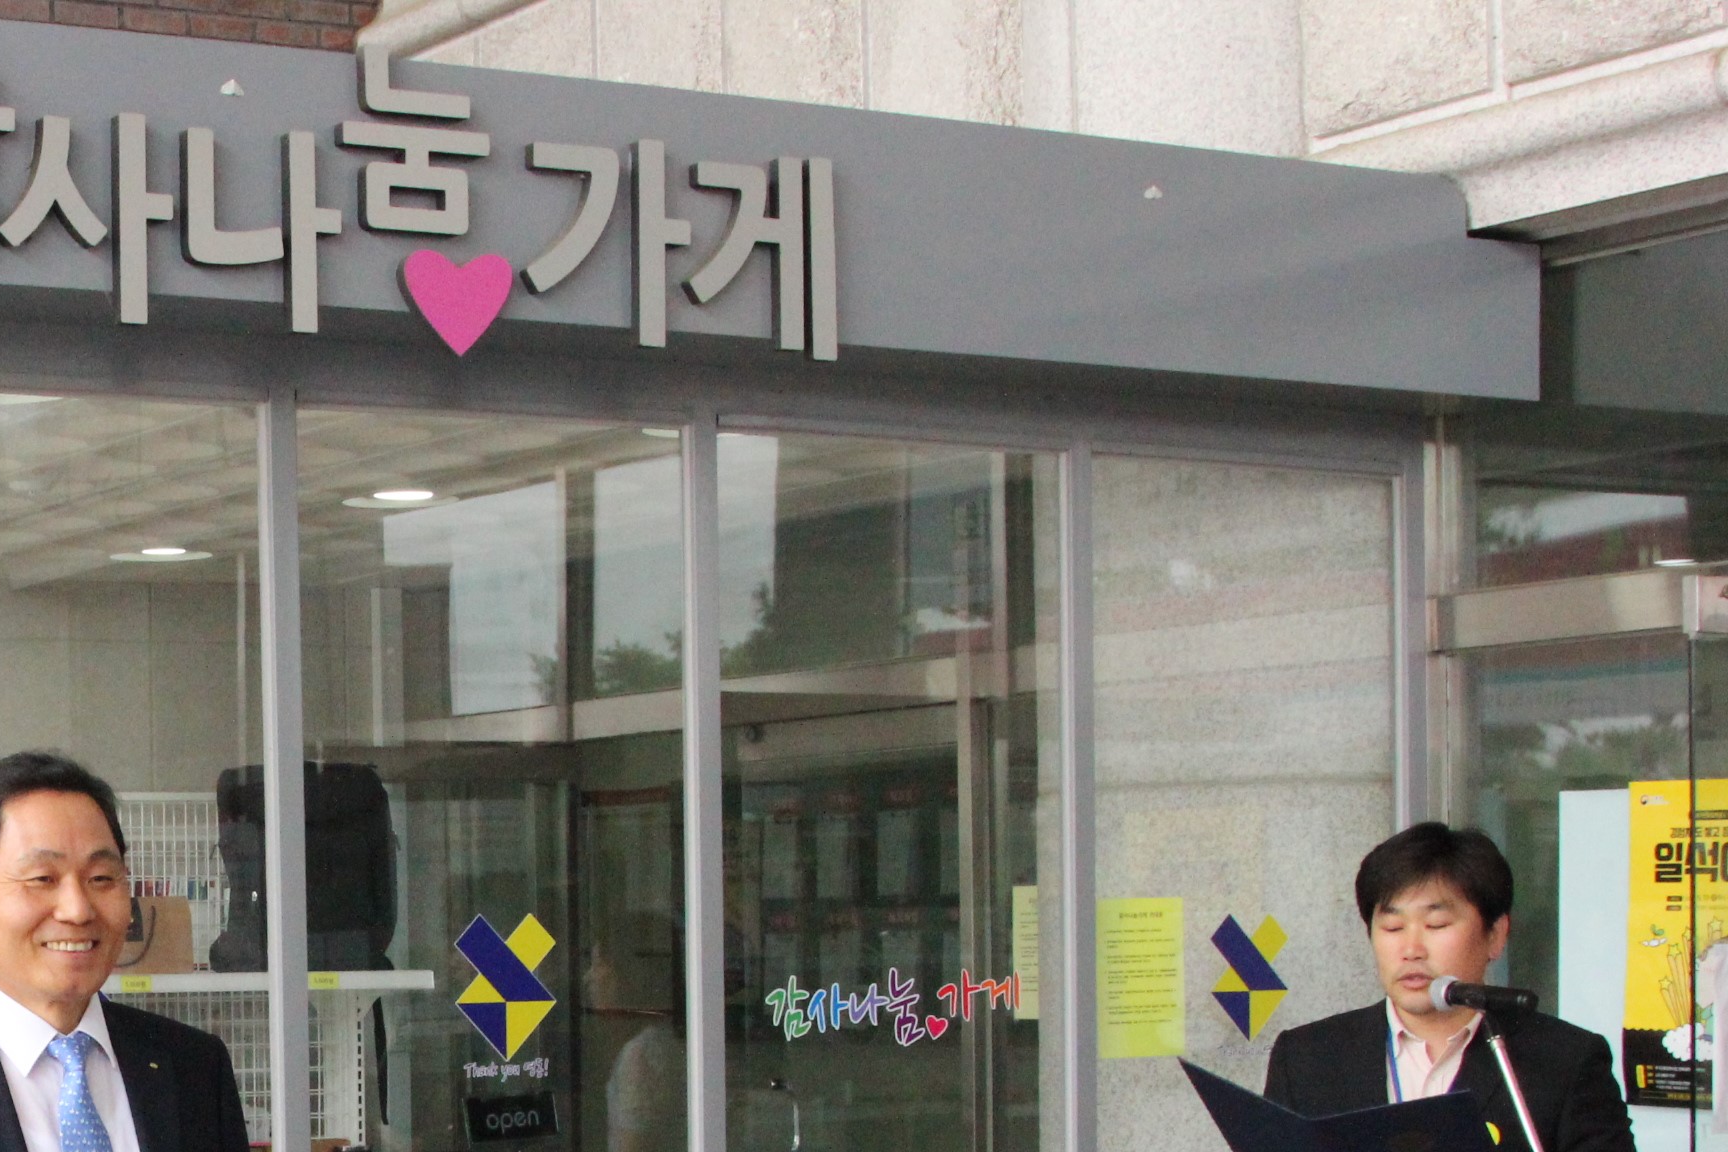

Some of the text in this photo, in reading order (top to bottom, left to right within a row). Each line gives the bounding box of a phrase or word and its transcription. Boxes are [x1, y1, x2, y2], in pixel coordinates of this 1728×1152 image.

[519, 139, 839, 362] 가게
[1654, 841, 1728, 883] 일석
[765, 966, 1021, 1047] 감사나눔 가게
[463, 1061, 499, 1079] Thank
[500, 1064, 521, 1083] you
[486, 1110, 540, 1134] open
